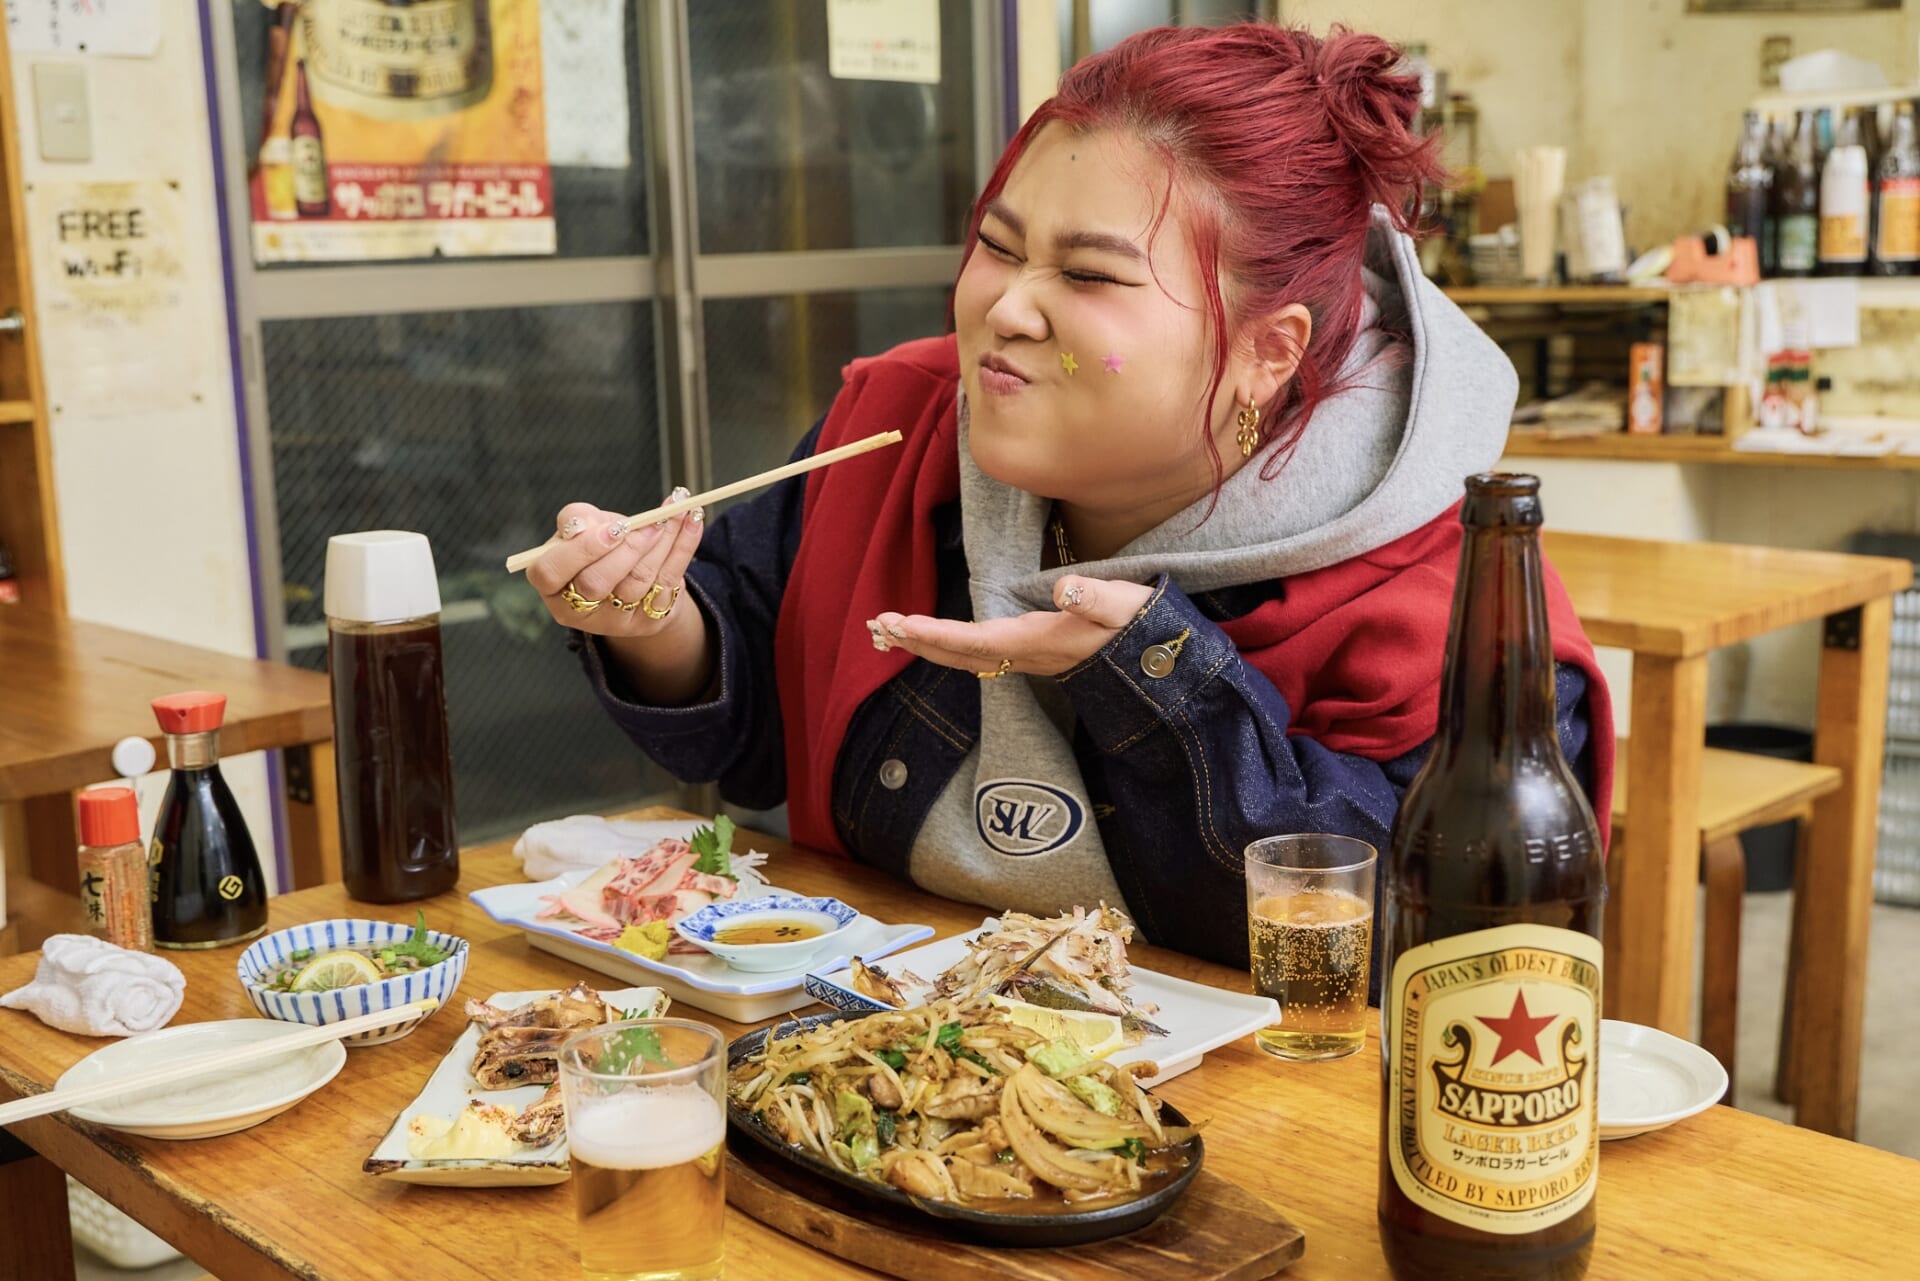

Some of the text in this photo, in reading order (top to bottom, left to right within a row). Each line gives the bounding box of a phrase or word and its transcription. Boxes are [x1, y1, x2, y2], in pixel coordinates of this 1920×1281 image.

[57, 209, 147, 242] FREE
[81, 871, 105, 922] 七味
[1422, 960, 1484, 993] JAPAN'S
[1490, 953, 1556, 976] OLDEST
[1402, 1007, 1420, 1080] BREWED
[1402, 1087, 1417, 1122] AND
[1440, 1078, 1581, 1126] SAPPORO
[1443, 1121, 1579, 1154] LAGER BEER
[1402, 1125, 1458, 1193] BOTTLED
[1452, 1147, 1569, 1171] サッポロラガービール
[1465, 1182, 1489, 1202] BY
[1495, 1177, 1569, 1207] SAPPORO
